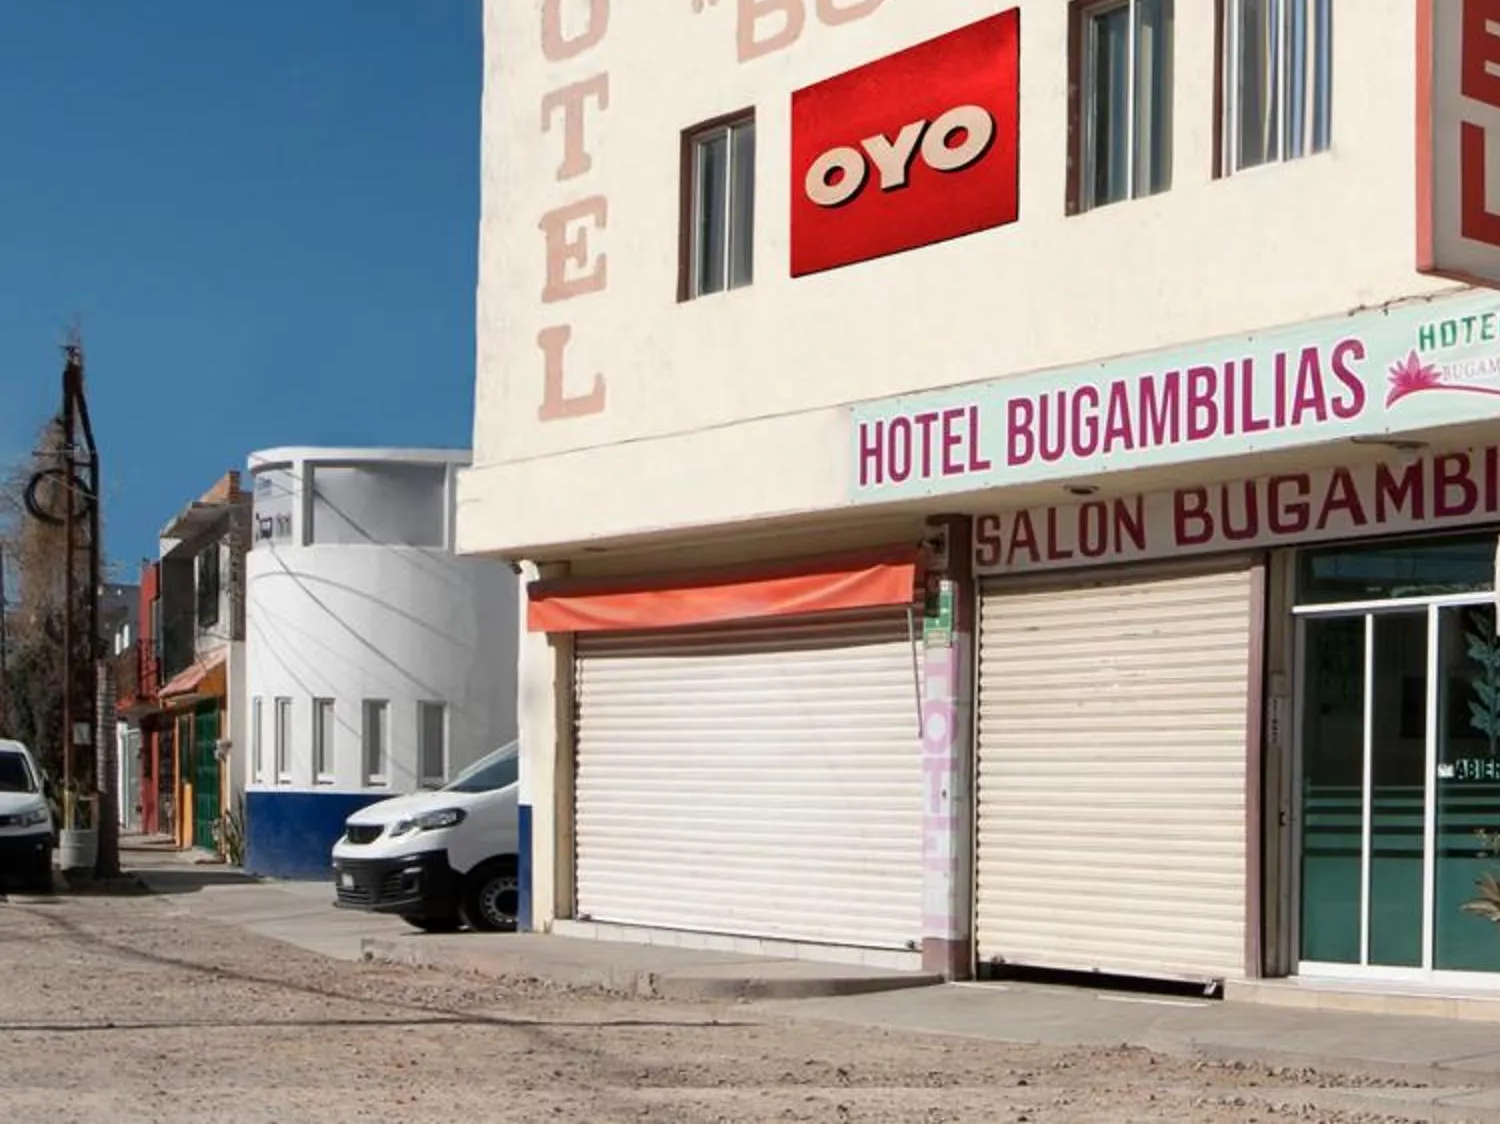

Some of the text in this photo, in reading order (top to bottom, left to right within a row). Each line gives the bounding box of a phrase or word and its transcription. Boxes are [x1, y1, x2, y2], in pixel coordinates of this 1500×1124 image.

[804, 104, 996, 207] OYO
[858, 336, 1368, 487] HOTEL BUGAMBILIAS
[974, 496, 1147, 568] SALON
